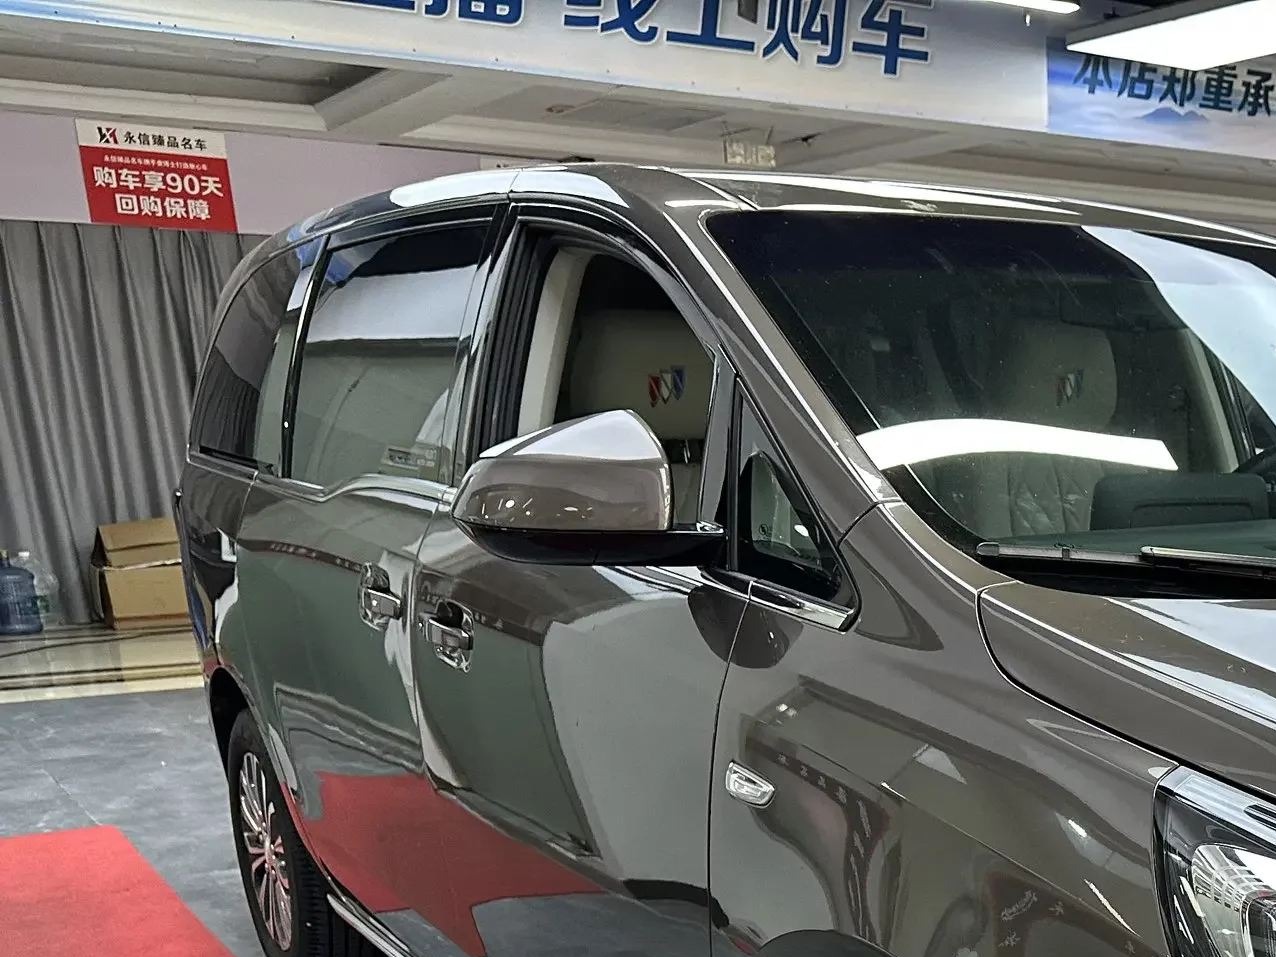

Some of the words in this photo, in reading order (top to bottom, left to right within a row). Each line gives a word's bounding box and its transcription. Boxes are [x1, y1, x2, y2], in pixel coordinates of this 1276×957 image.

[124, 131, 207, 151] 永信臻品名车
[93, 166, 224, 197] 购车享90天
[115, 193, 211, 220] 回购保障
